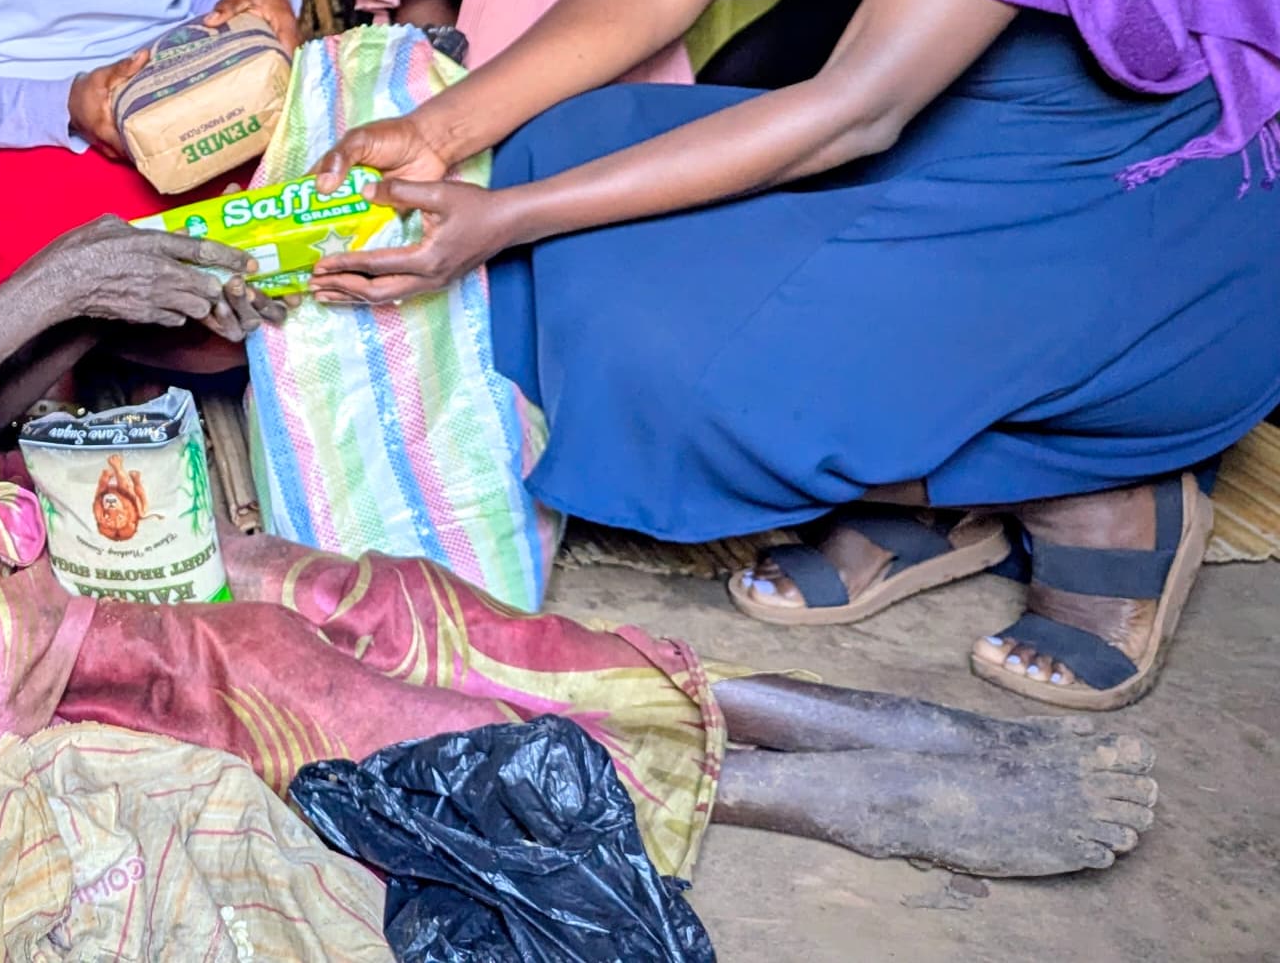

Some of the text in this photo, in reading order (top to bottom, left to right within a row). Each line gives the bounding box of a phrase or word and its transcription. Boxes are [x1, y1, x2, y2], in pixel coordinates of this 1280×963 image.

[181, 114, 262, 165] PEMBE
[300, 206, 352, 223] GRADE
[49, 424, 167, 444] Pure Cane Sugar
[50, 542, 217, 581] LIGHT BROWN SUGA
